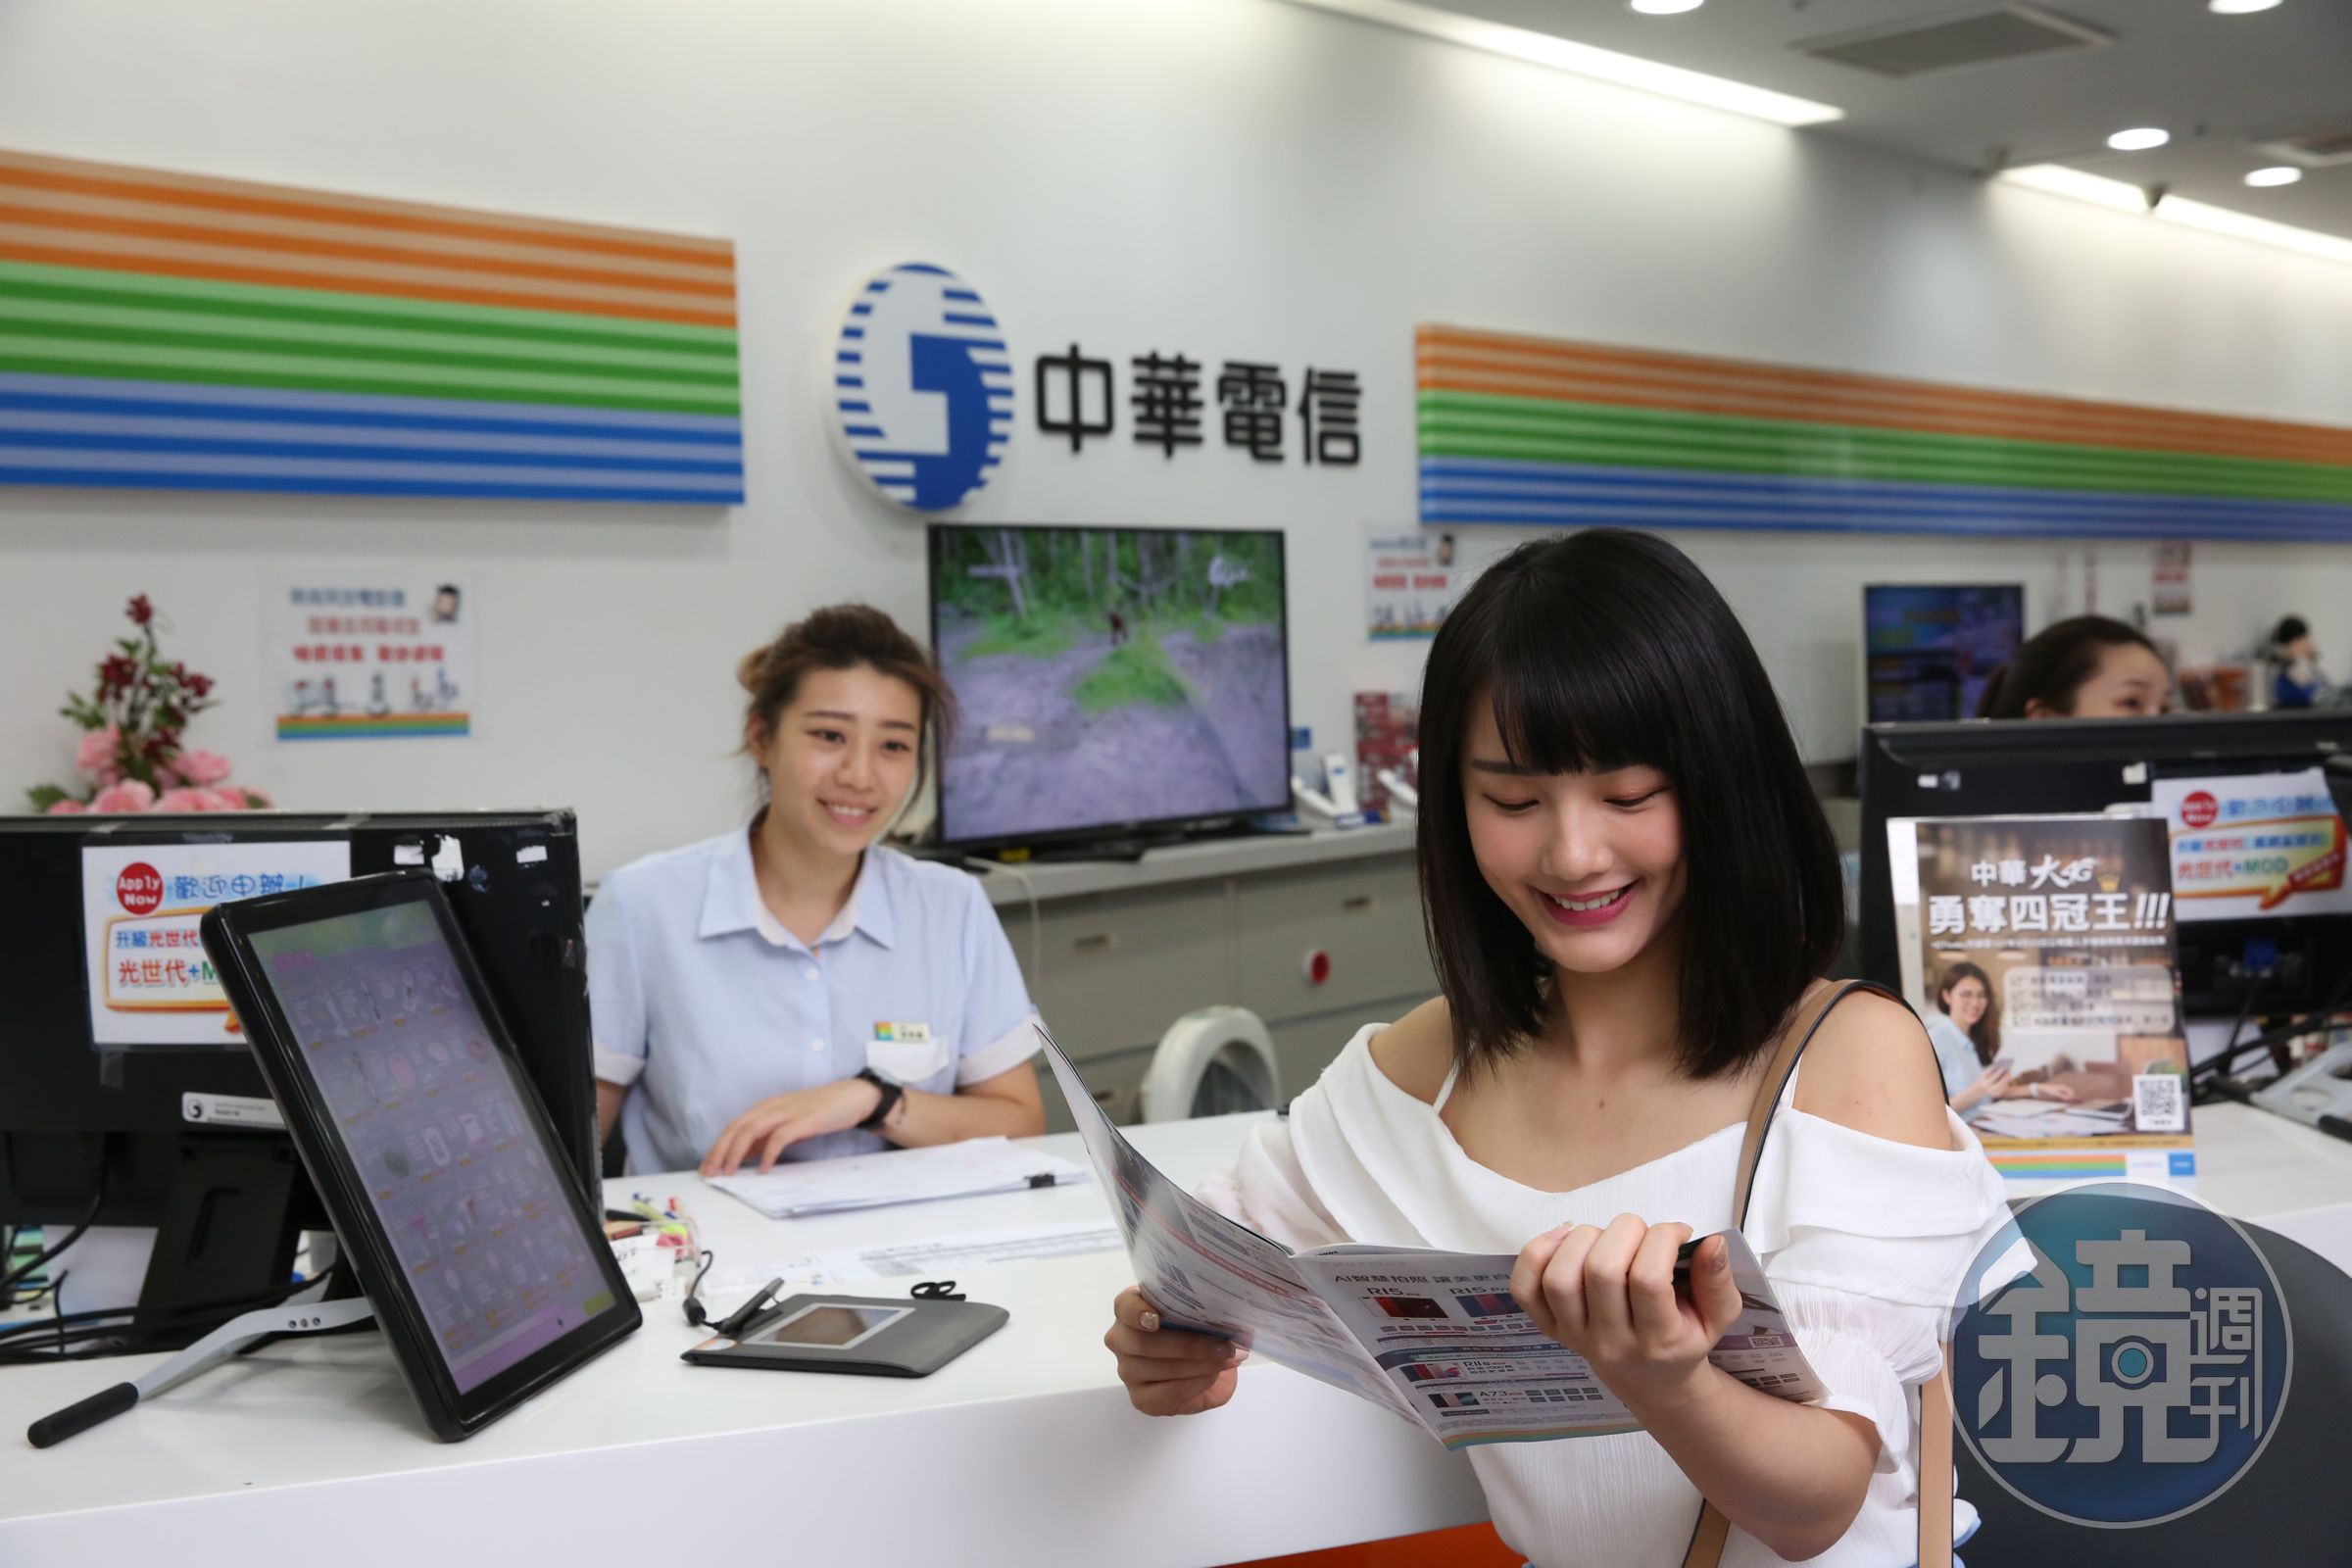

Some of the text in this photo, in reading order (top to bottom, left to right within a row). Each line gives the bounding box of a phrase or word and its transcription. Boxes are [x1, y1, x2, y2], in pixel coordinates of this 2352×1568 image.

[1034, 342, 1362, 466] 中華電信
[119, 874, 160, 892] Apply
[124, 892, 158, 906] Now
[1928, 892, 2171, 935] 勇奪四冠王!!!
